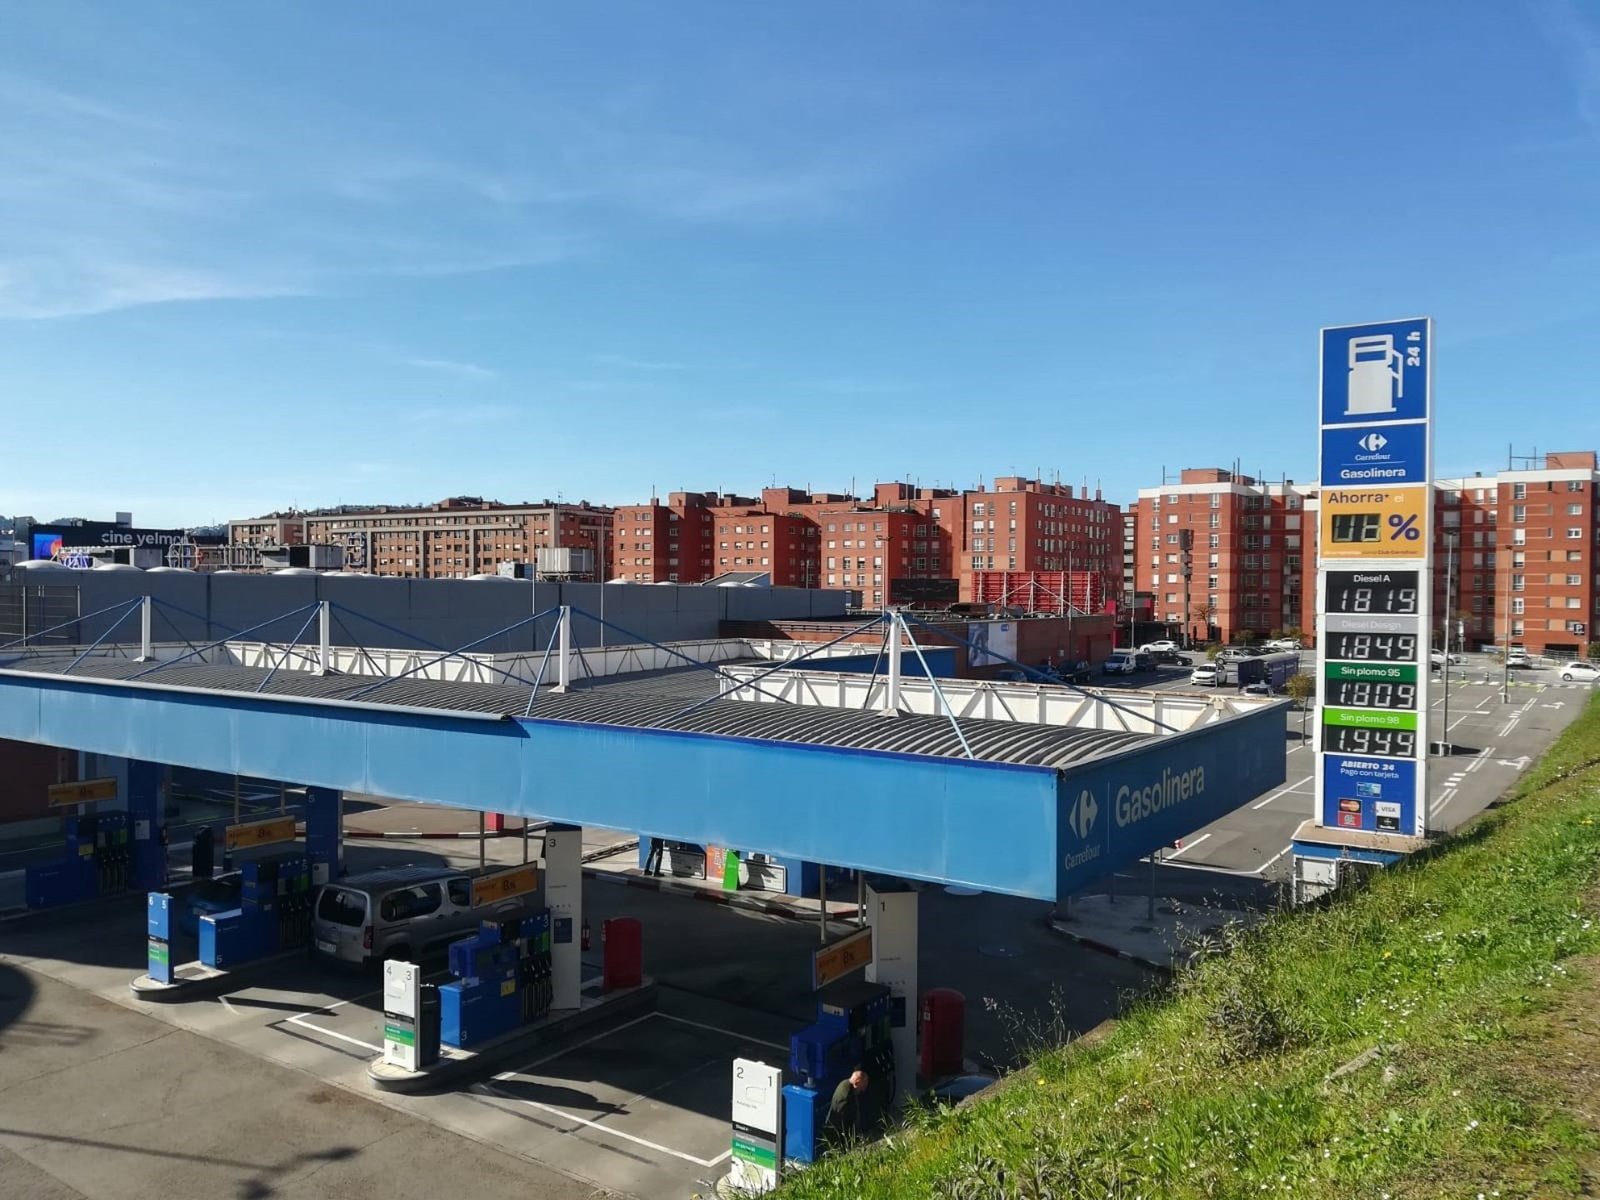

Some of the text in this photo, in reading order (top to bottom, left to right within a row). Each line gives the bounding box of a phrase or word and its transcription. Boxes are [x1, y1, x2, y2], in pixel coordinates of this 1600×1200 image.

[1406, 331, 1420, 366] 24 h
[1355, 453, 1391, 461] Carrefour
[1341, 468, 1406, 479] Gasolinera
[1388, 513, 1420, 541] %
[102, 530, 133, 544] cine
[1353, 574, 1391, 583] Diesel A
[1341, 620, 1369, 629] Diesel
[1340, 635, 1415, 660] 1.849
[1341, 667, 1401, 677] Sin plomo 95
[1340, 713, 1400, 725] Sin plomo 98
[1338, 729, 1414, 756] 1.949
[1340, 760, 1395, 771] ABIERTO 24
[1340, 767, 1359, 777] Pago
[1374, 771, 1399, 779] tarjeta
[1115, 765, 1205, 828] Gasolinera
[548, 838, 557, 848] 3
[1065, 844, 1101, 870] Carrefour
[386, 966, 412, 981] 4 3
[461, 1030, 468, 1041] 3
[736, 1066, 773, 1088] 2 1
